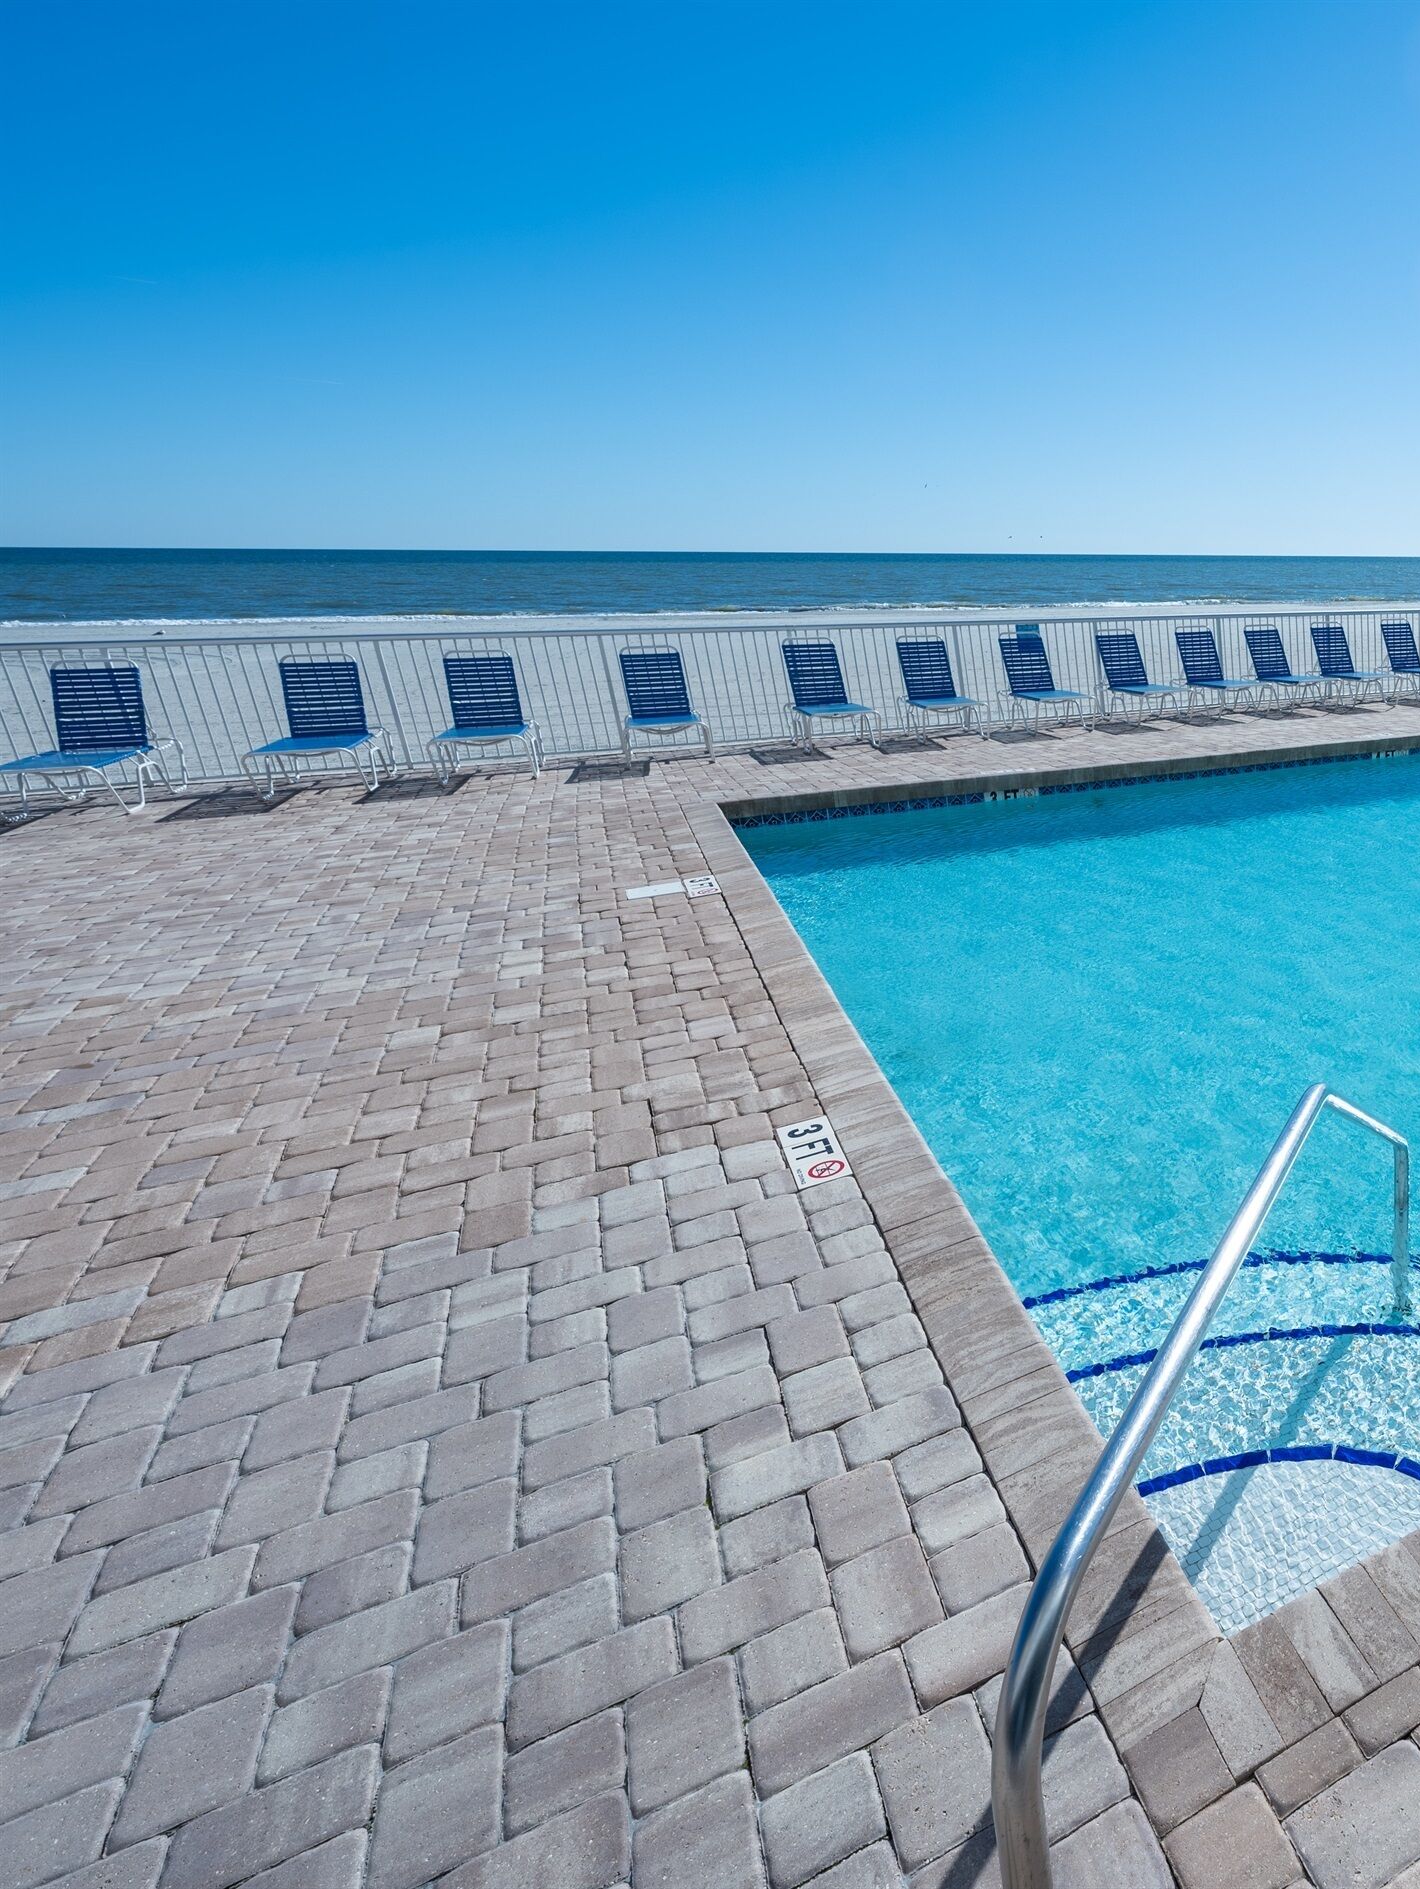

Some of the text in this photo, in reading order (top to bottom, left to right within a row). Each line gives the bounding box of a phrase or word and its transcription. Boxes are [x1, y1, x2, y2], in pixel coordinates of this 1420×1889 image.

[1004, 789, 1019, 800] FT
[787, 1124, 834, 1160] 3 FT
